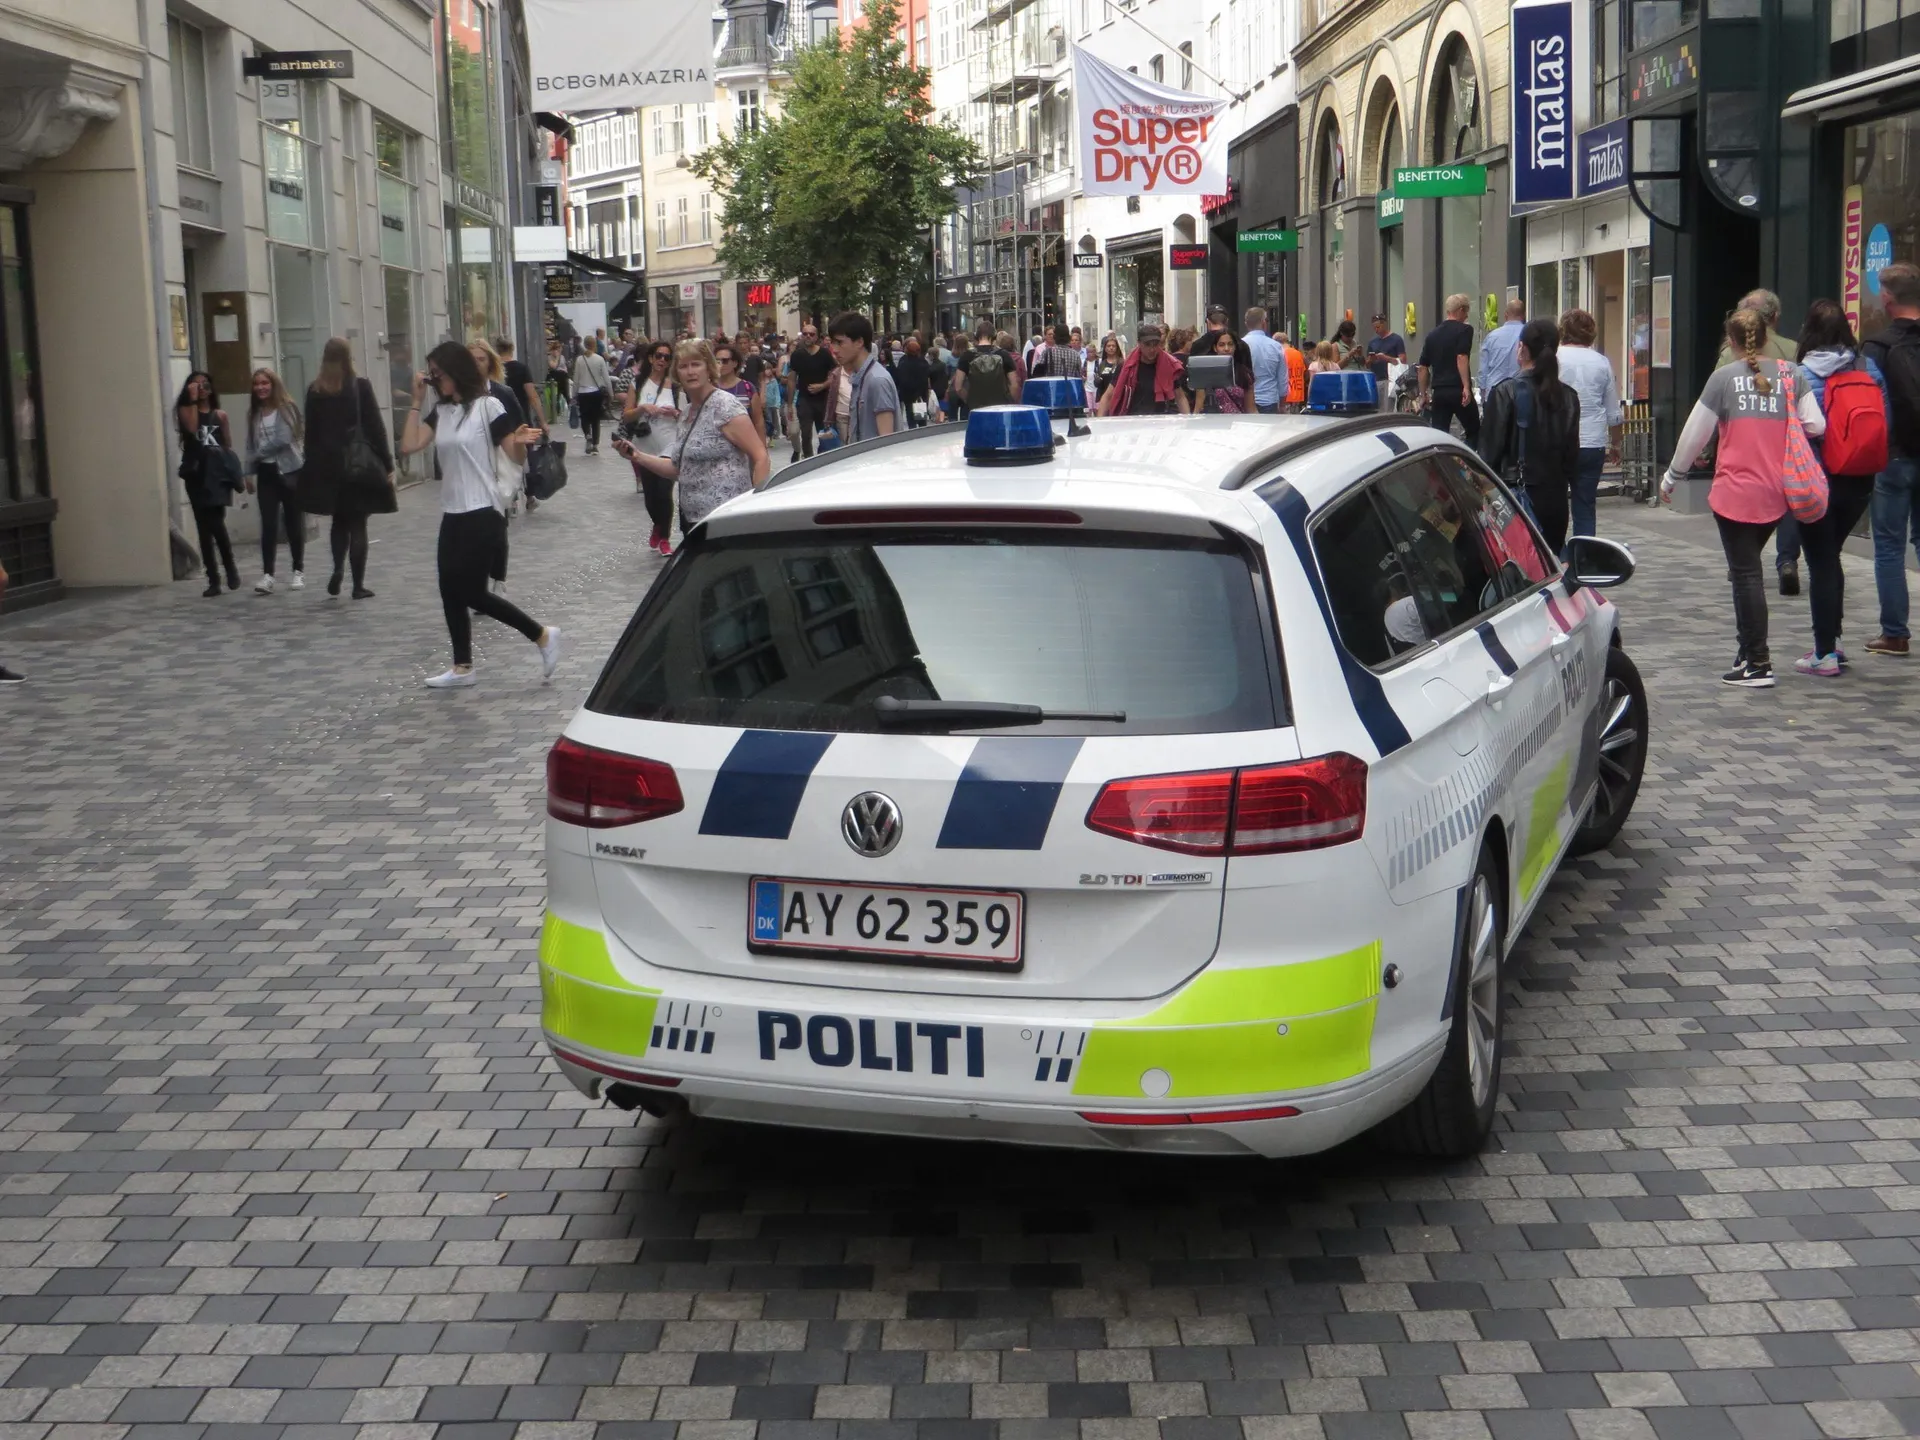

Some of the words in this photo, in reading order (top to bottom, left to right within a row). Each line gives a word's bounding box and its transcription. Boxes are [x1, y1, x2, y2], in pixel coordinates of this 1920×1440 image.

[269, 59, 345, 71] marimekko
[536, 68, 708, 91] BCBGMAXAZRIA
[1524, 35, 1565, 170] matas
[1092, 108, 1214, 155] Super
[1588, 132, 1624, 187] matas
[1398, 169, 1464, 182] BENETTON.
[1870, 241, 1888, 255] SLUT
[1077, 256, 1100, 266] VANS
[1738, 395, 1778, 413] STER
[595, 842, 647, 860] PASSAT
[1111, 874, 1142, 885] TDI
[1152, 873, 1206, 882] BLUEMOTION
[757, 916, 775, 930] DK
[784, 891, 843, 936] AY
[856, 894, 910, 942] 62
[924, 899, 1011, 949] 359
[757, 1010, 985, 1078] POLITI
